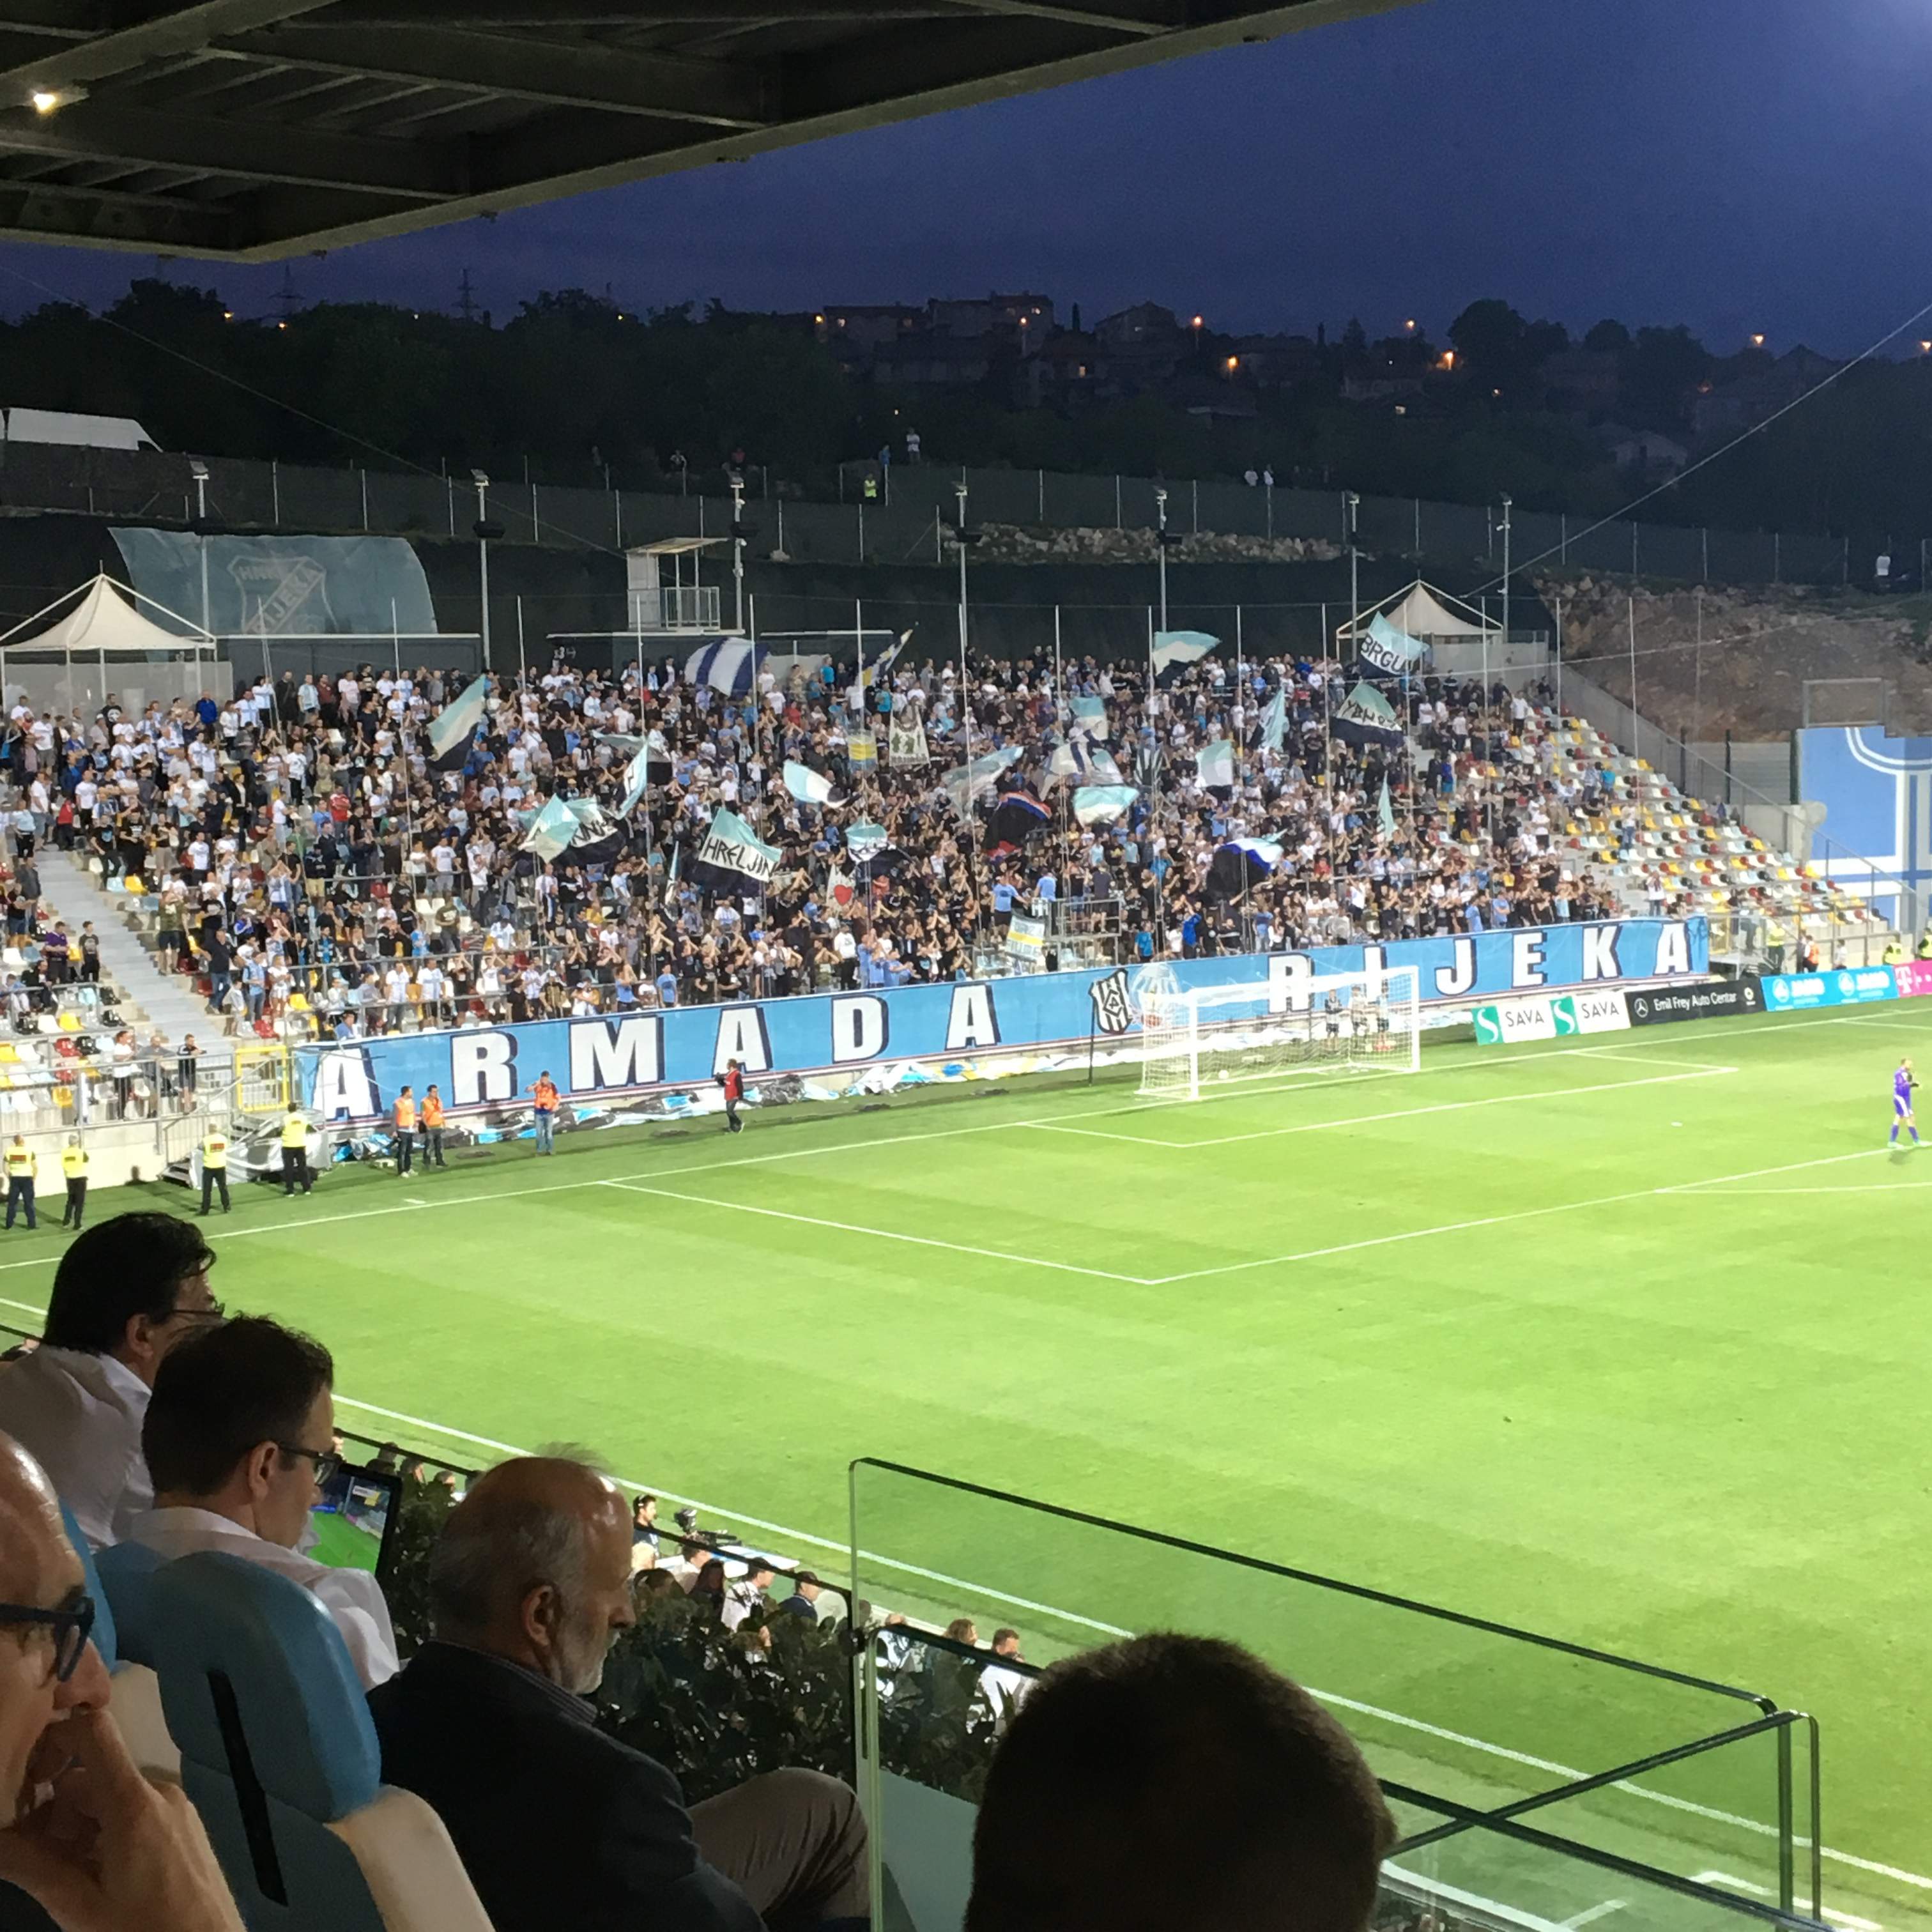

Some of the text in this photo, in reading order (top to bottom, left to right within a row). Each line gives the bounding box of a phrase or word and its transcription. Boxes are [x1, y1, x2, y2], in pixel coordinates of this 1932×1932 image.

[1581, 1002, 1620, 1018] SAVA
[1653, 998, 1672, 1011] Emil
[1672, 996, 1690, 1011] Frey
[1692, 995, 1710, 1007] Auto
[312, 921, 1692, 1120] ARMADA RIJEKA
[1505, 1009, 1544, 1027] SAVA
